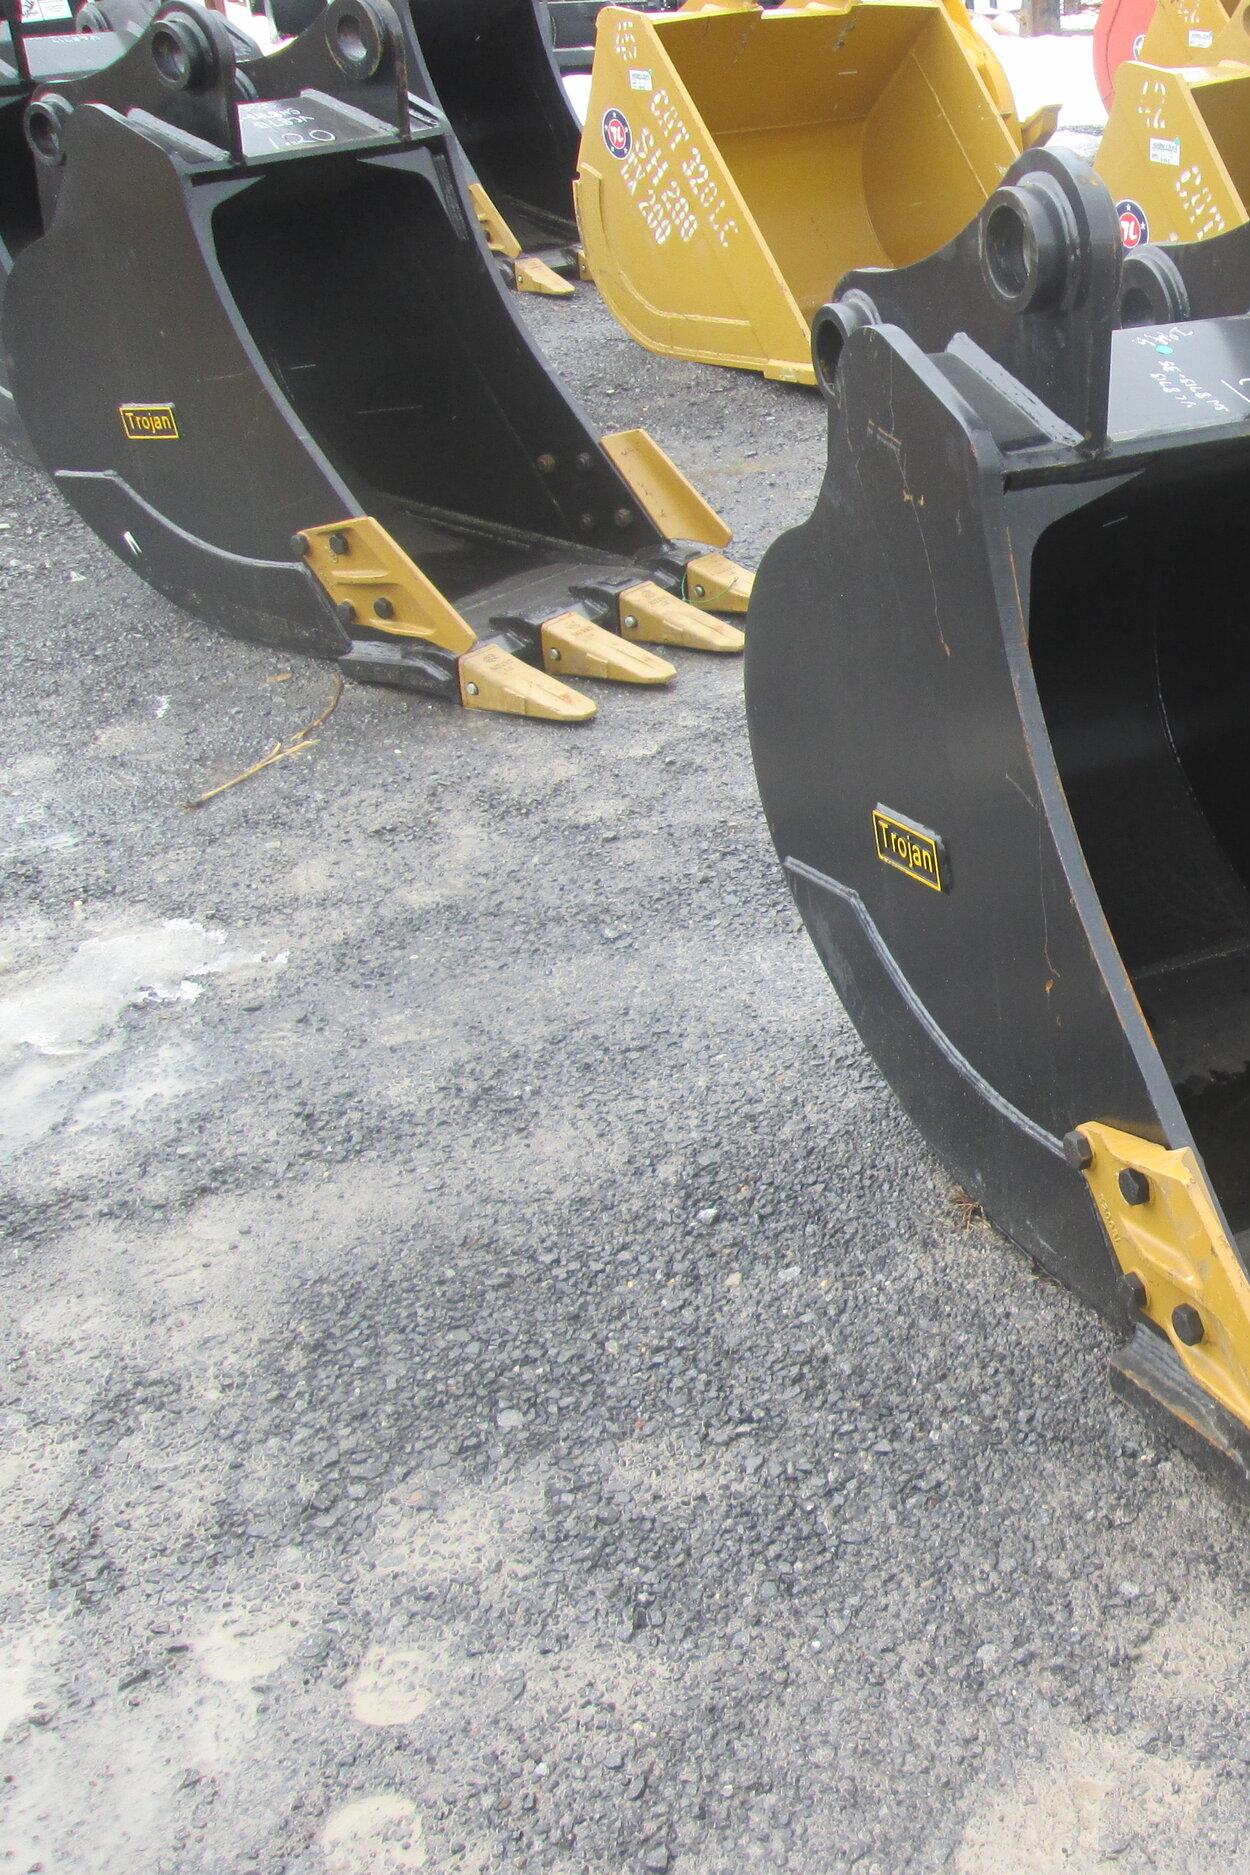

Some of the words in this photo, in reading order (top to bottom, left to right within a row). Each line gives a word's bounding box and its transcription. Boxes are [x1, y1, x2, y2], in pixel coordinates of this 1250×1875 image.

[635, 127, 669, 186] SH
[661, 180, 698, 243] 200
[650, 89, 690, 152] CAT
[682, 147, 718, 207] 320
[1175, 165, 1225, 240] CAT
[124, 412, 172, 434] Trojan
[878, 820, 933, 873] Trojan
